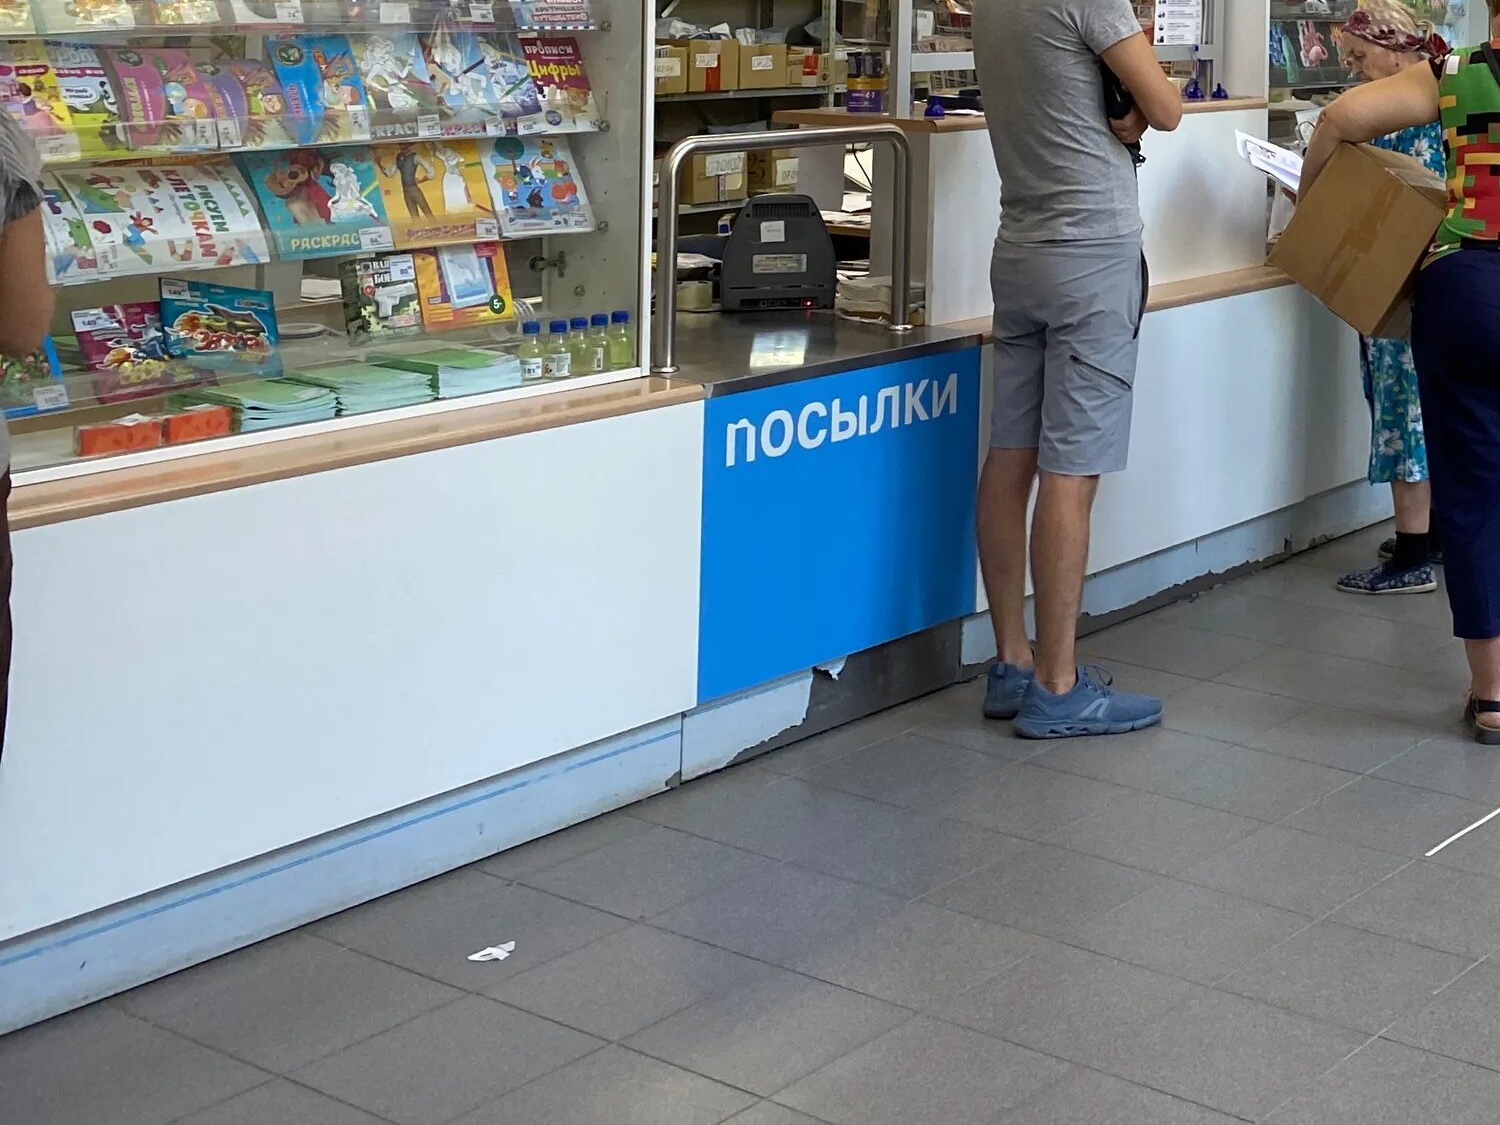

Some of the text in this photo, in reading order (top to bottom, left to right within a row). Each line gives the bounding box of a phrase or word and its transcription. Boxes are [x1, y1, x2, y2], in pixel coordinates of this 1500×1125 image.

[524, 42, 573, 54] ПРОПИСИ
[526, 59, 580, 82] Цифры
[290, 231, 360, 251] РАСКРАС
[725, 373, 958, 467] ПОСЫЛКИ
